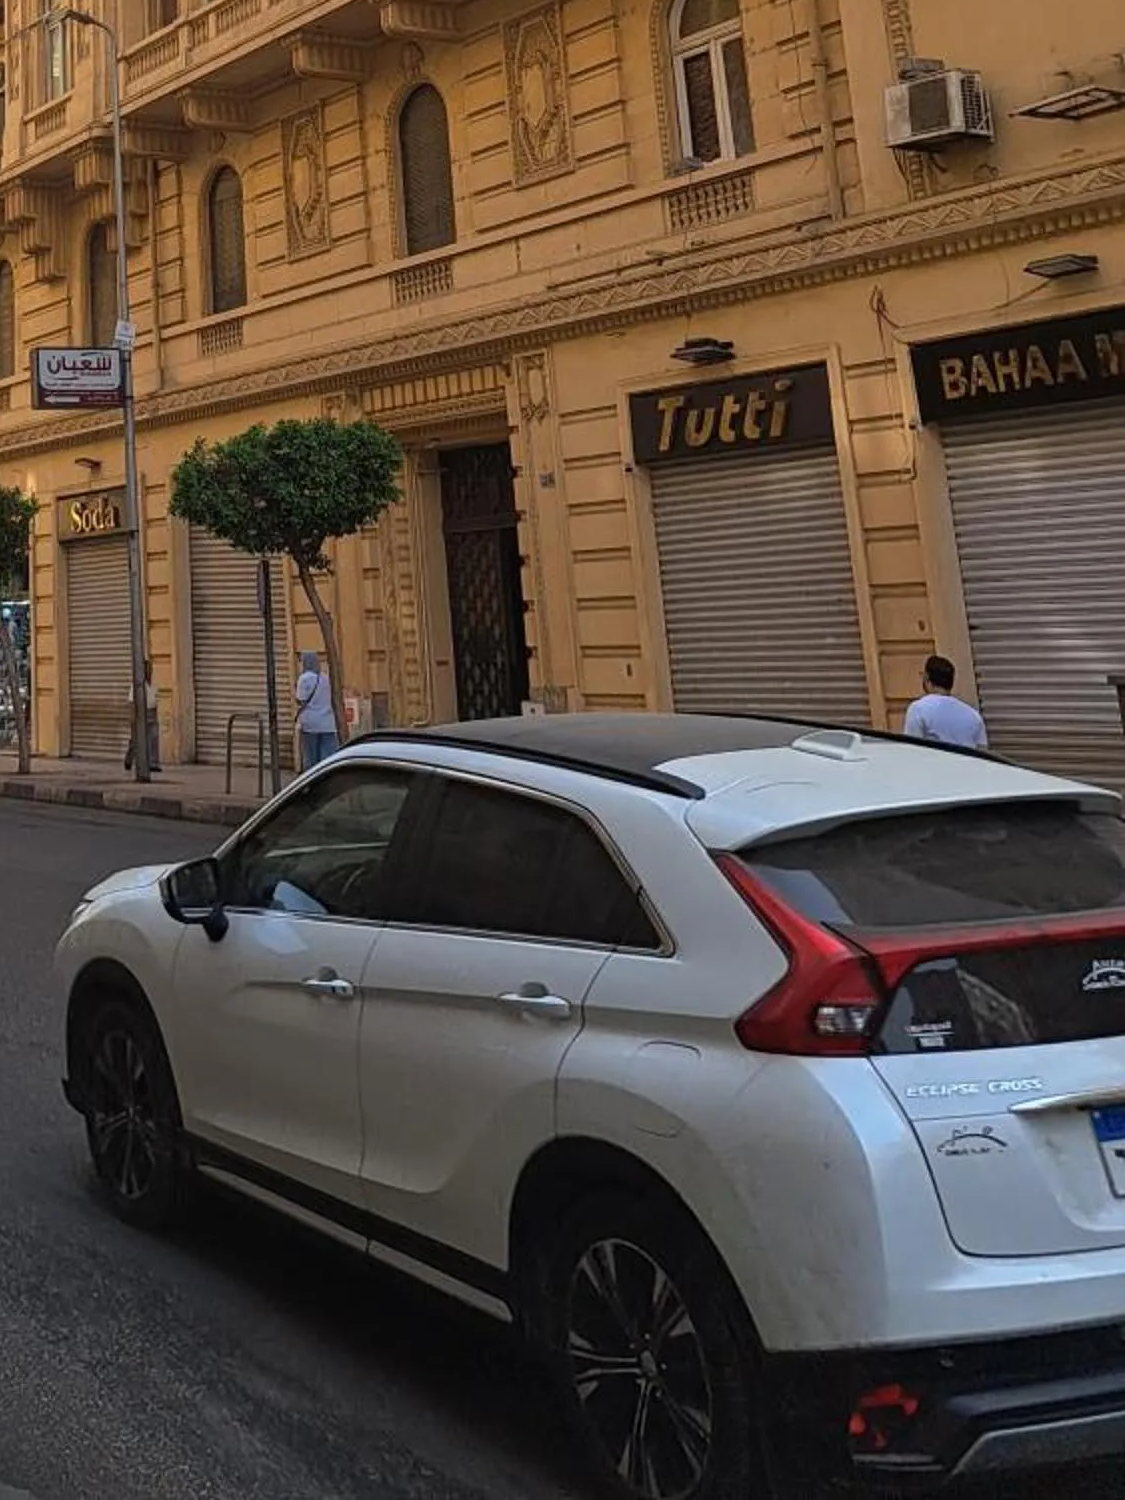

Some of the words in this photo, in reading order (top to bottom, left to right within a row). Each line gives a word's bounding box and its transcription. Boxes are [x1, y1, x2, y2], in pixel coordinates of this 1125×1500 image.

[939, 339, 1088, 400] BAHAA
[657, 378, 793, 453] Tutti
[70, 497, 116, 534] Soda
[906, 1082, 979, 1099] ECLIPSE
[987, 1077, 1043, 1095] CROSS
